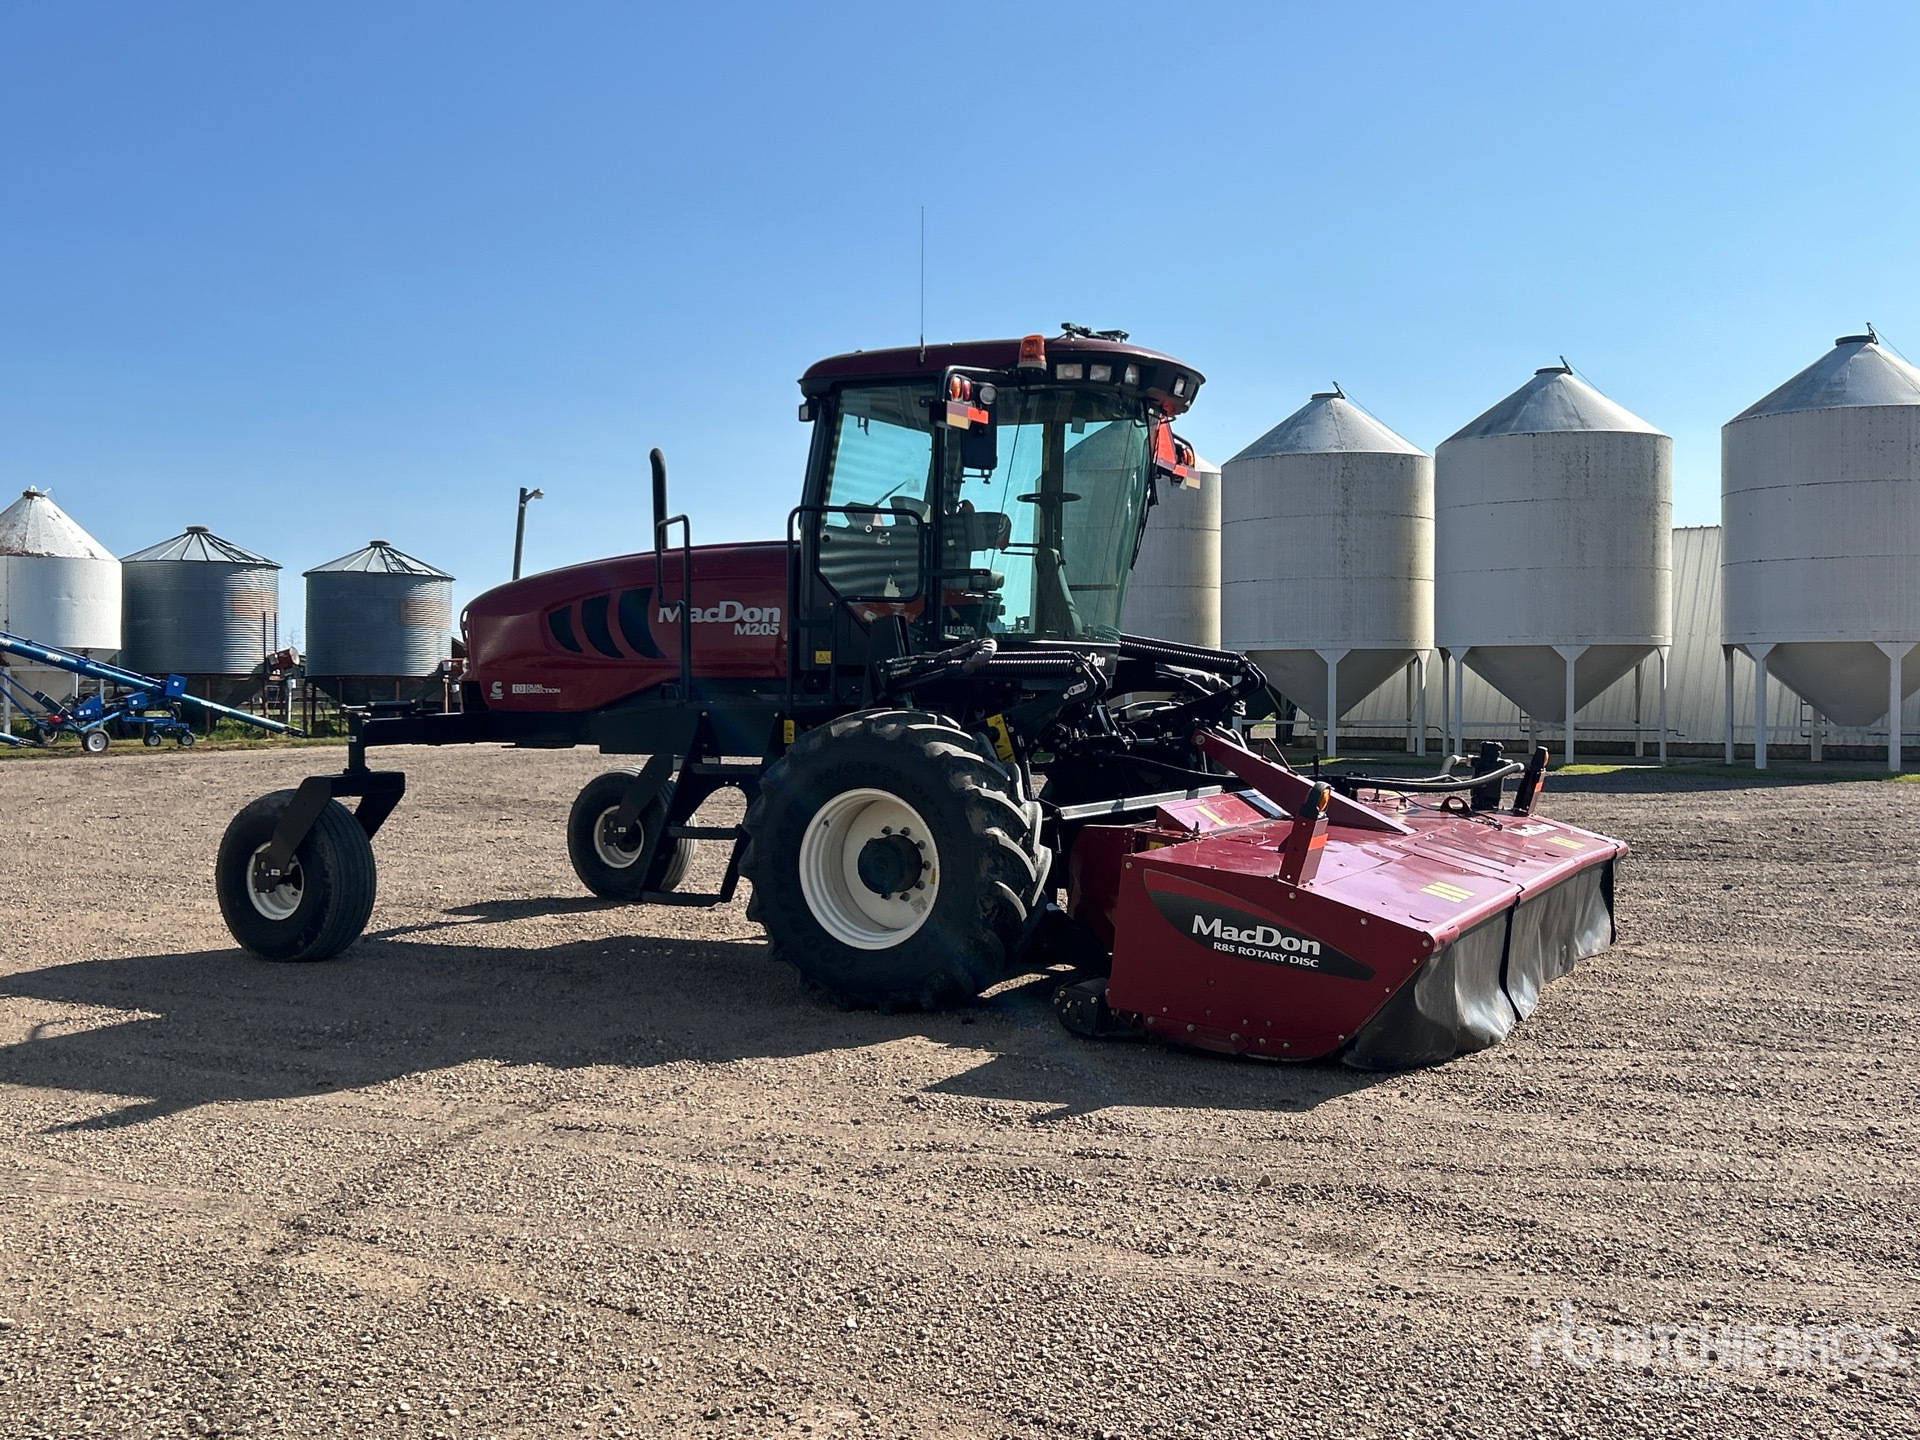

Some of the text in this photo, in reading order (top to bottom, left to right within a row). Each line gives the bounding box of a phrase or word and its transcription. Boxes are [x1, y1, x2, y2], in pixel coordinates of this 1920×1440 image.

[658, 601, 781, 623] MacDon
[734, 623, 780, 636] M205
[1192, 914, 1321, 956] MacDon
[1213, 942, 1319, 968] R85 ROTARY DISC
